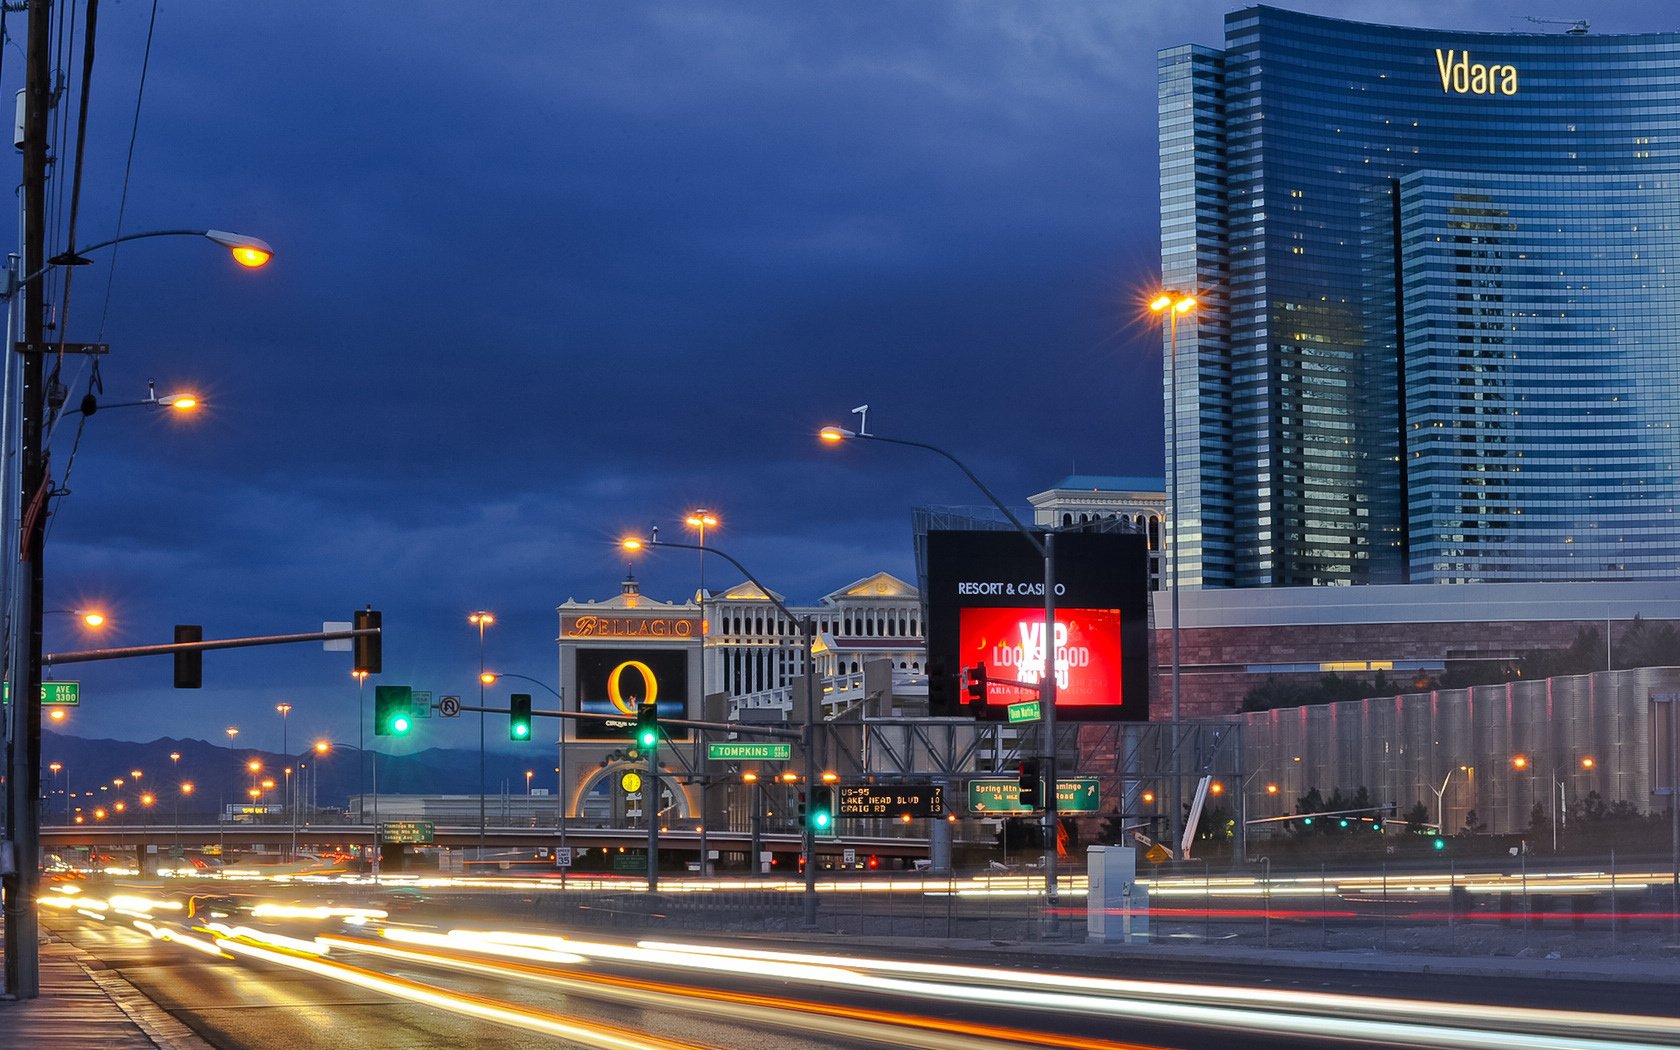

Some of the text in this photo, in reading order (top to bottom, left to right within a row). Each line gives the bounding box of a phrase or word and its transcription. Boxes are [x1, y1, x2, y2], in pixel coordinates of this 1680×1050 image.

[1435, 48, 1518, 96] Vdara
[958, 582, 1066, 596] RESORT & CASIO
[568, 615, 692, 638] BELLAGIO
[56, 685, 70, 693] AVE
[719, 747, 768, 756] TOMPKINS
[841, 788, 941, 796] US-95 7
[975, 785, 1001, 794] Spring
[841, 805, 941, 813] CRAIG RD 13
